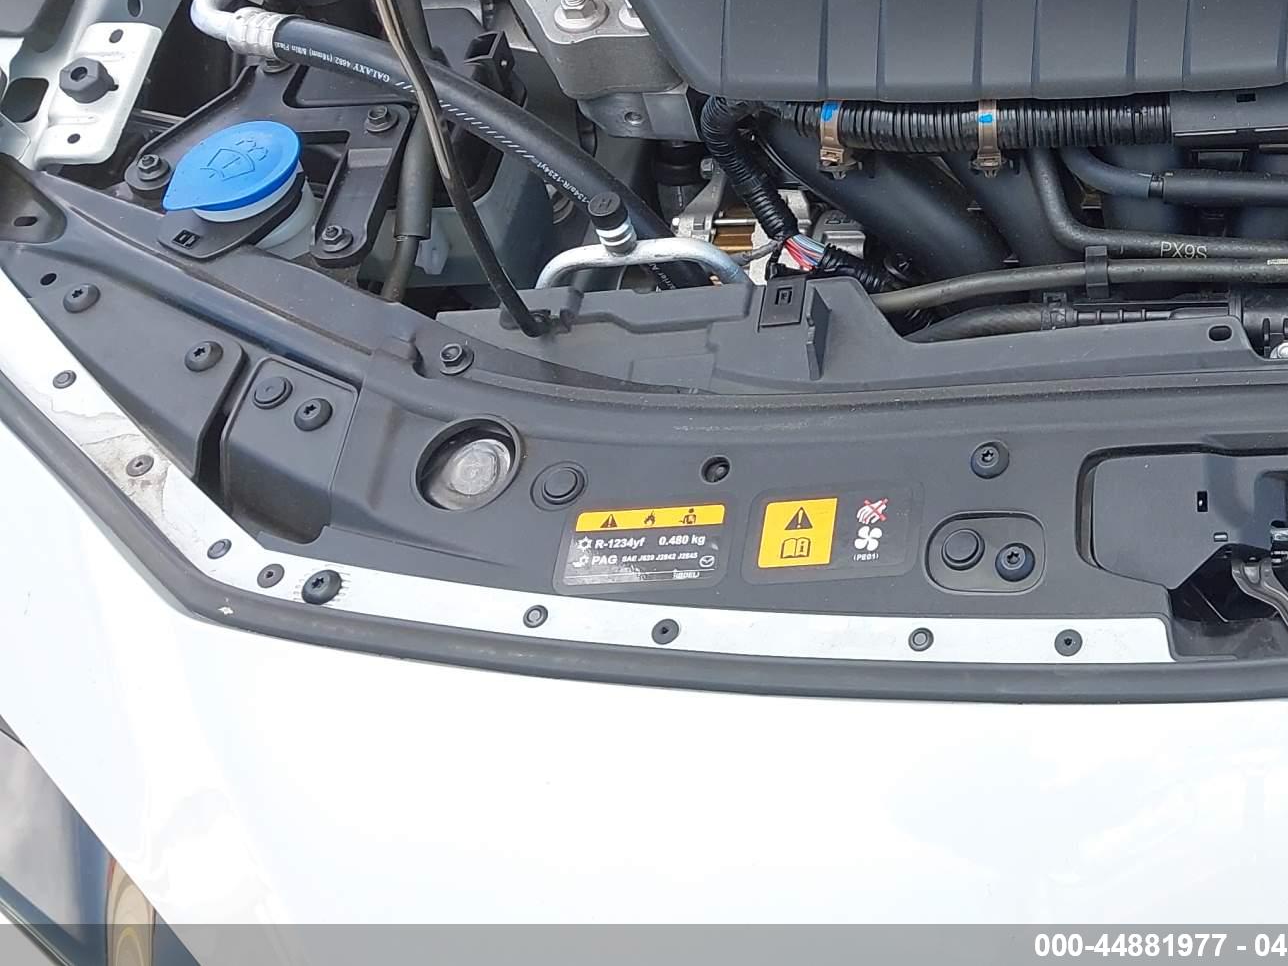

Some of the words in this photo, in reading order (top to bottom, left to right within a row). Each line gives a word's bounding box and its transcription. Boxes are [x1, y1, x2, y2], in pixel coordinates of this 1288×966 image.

[353, 63, 390, 83] GALAXY
[536, 161, 591, 204] -134a/R-1234yf
[1160, 241, 1208, 259] PX9S
[595, 537, 646, 550] R-1234yf
[658, 534, 689, 546] 0.480
[691, 534, 707, 546] kg
[591, 555, 618, 566] PAG
